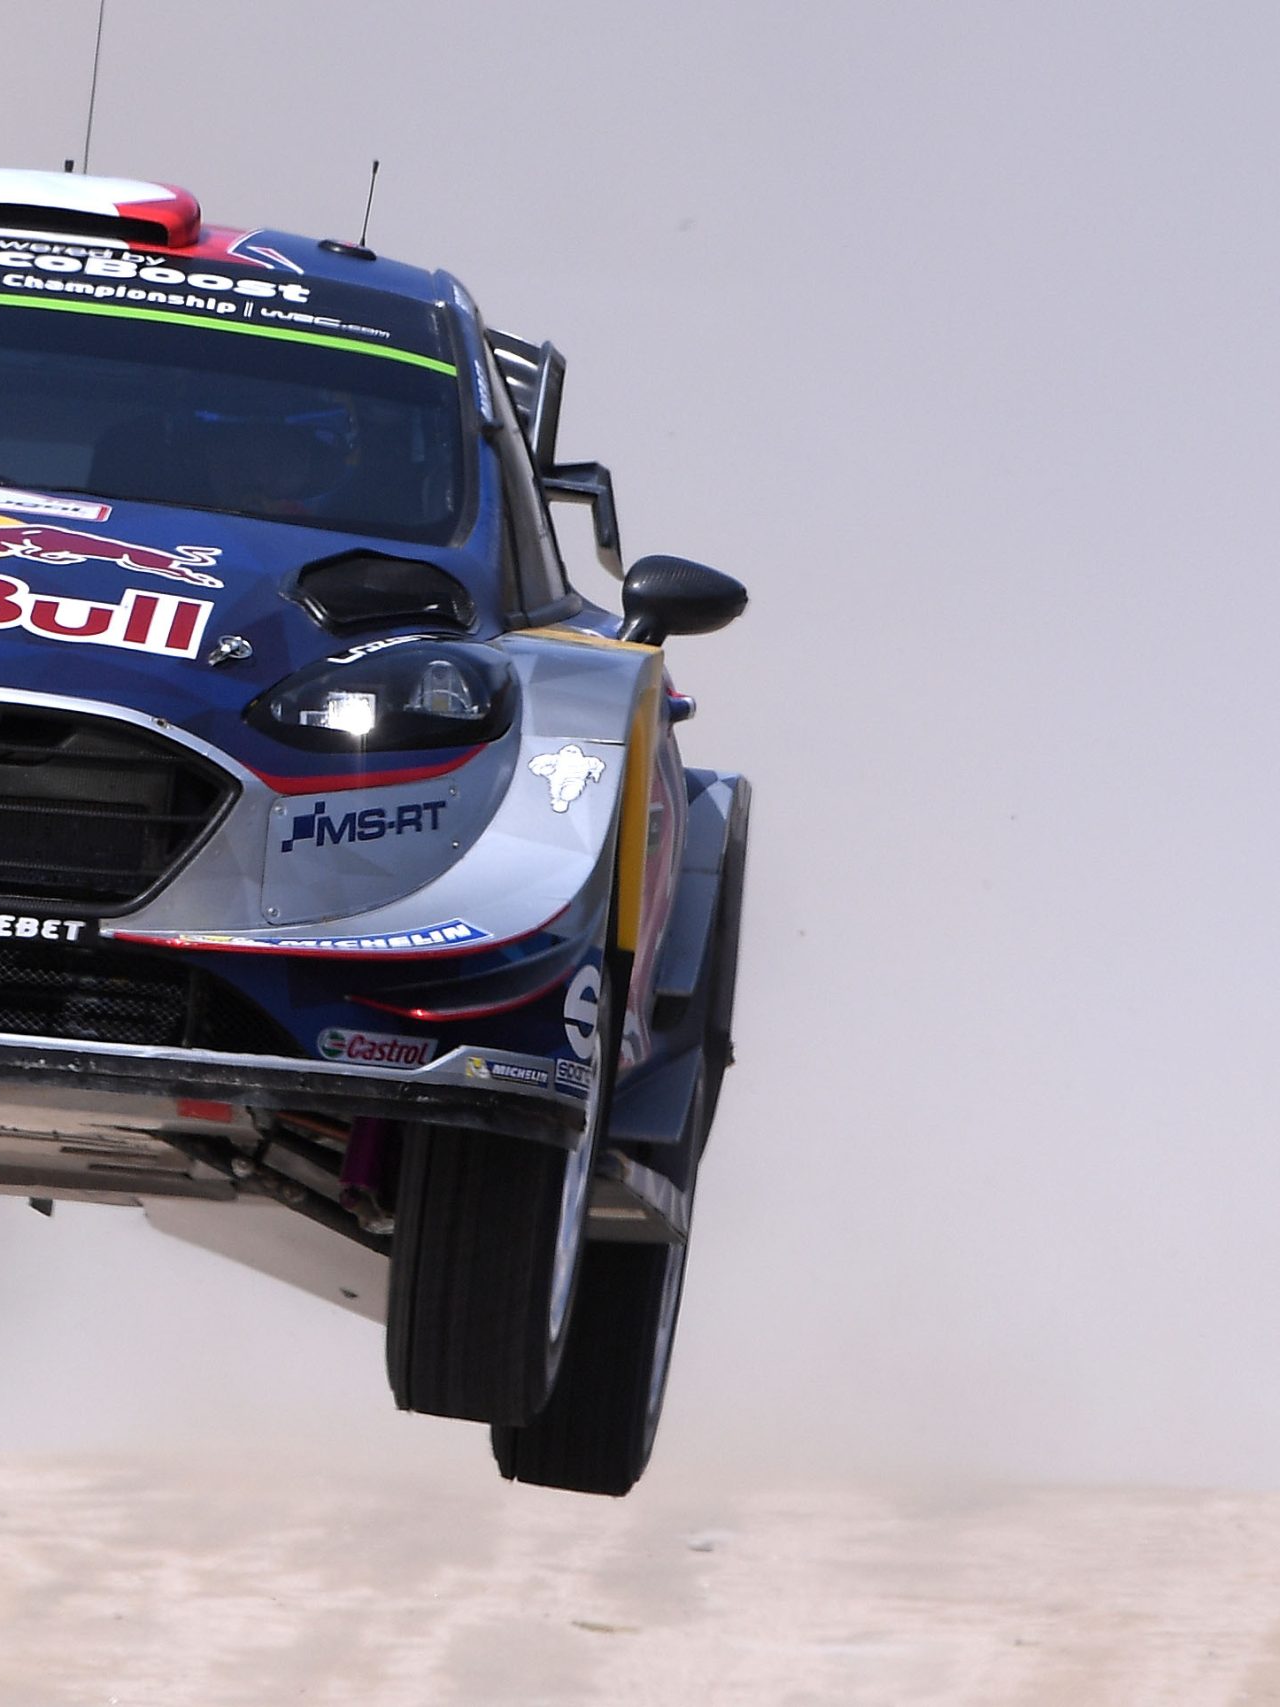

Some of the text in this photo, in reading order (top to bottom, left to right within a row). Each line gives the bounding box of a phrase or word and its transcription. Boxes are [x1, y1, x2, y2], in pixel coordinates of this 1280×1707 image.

[121, 251, 167, 266] by
[2, 273, 237, 314] Championship
[315, 801, 447, 847] MS-RT
[346, 1033, 430, 1067] Castrol
[491, 1063, 549, 1083] MICHELIN
